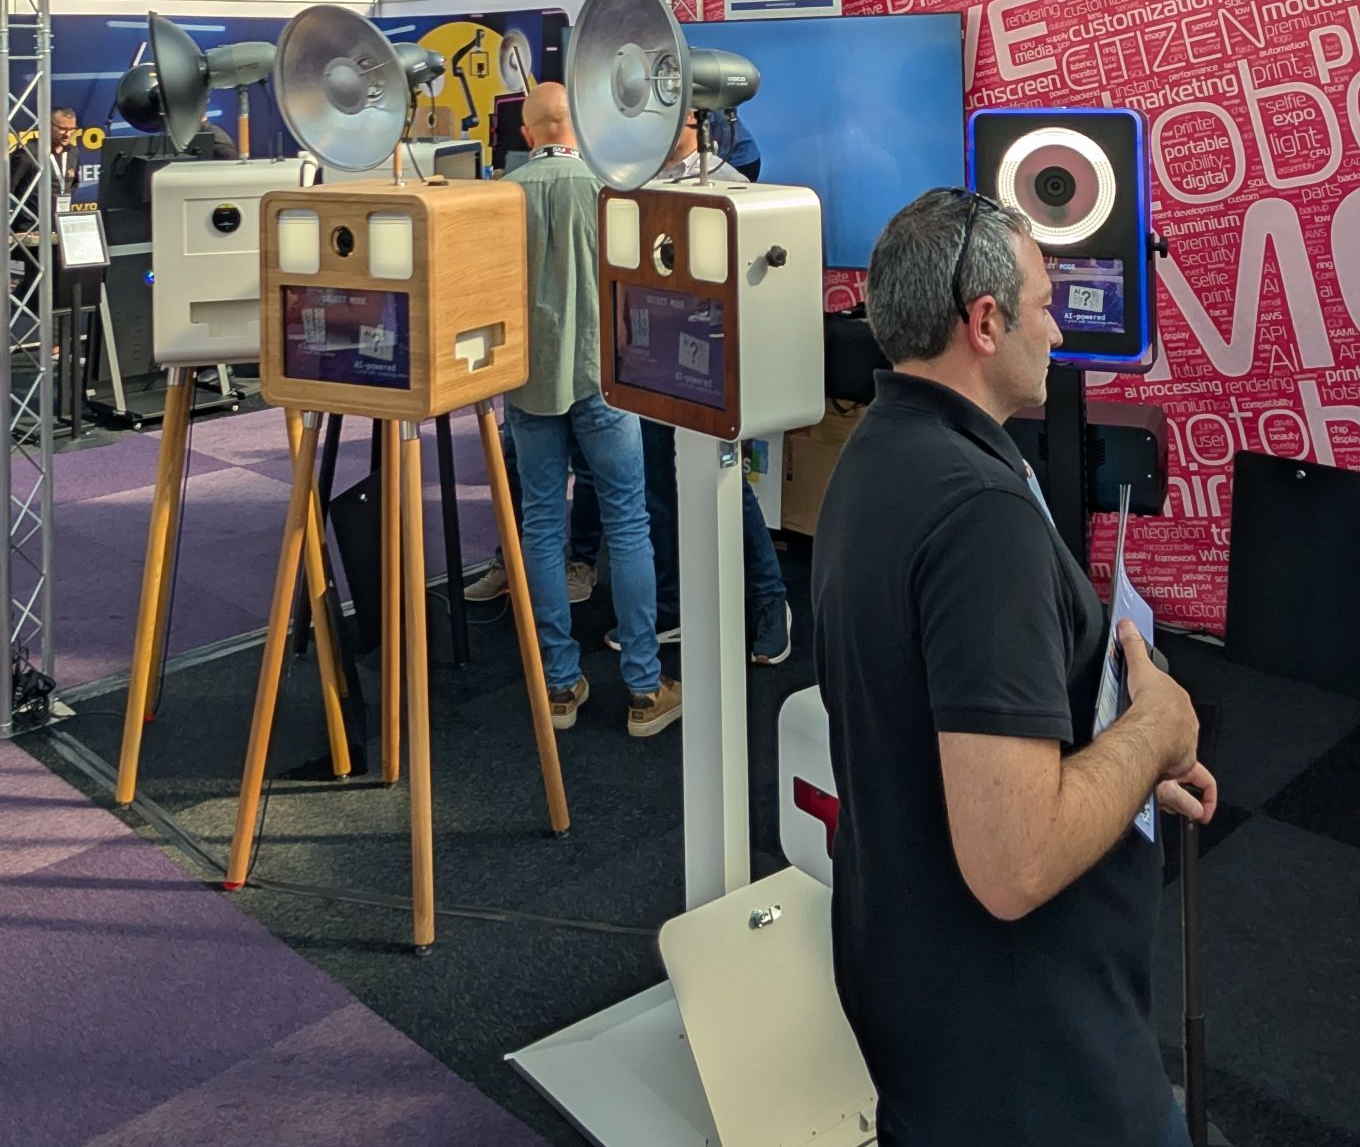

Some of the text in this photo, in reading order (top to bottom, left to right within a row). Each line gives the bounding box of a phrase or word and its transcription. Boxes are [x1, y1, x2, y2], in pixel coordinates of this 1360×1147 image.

[1006, 3, 1061, 29] rendering
[1264, 9, 1334, 39] premium
[1015, 38, 1054, 64] media
[1062, 0, 1265, 91] CITIZEN
[1252, 53, 1301, 87] print
[1115, 76, 1160, 99] instant
[1125, 73, 1239, 110] marketing
[1266, 93, 1307, 114] selfie
[1173, 115, 1216, 138] printer
[1273, 107, 1316, 127] expo
[1165, 135, 1229, 162] portable
[1182, 168, 1228, 191] digital
[1227, 191, 1259, 204] custom
[1301, 182, 1342, 203] parts
[1173, 203, 1225, 219] development
[1162, 214, 1241, 237] aluminium
[1177, 231, 1240, 254] premium
[1180, 248, 1236, 267] security
[1191, 271, 1230, 289] selfie
[1202, 289, 1234, 307] print
[1259, 326, 1287, 342] API
[1139, 380, 1223, 398] processing
[1225, 377, 1294, 396] rendering
[1133, 523, 1205, 544] integration
